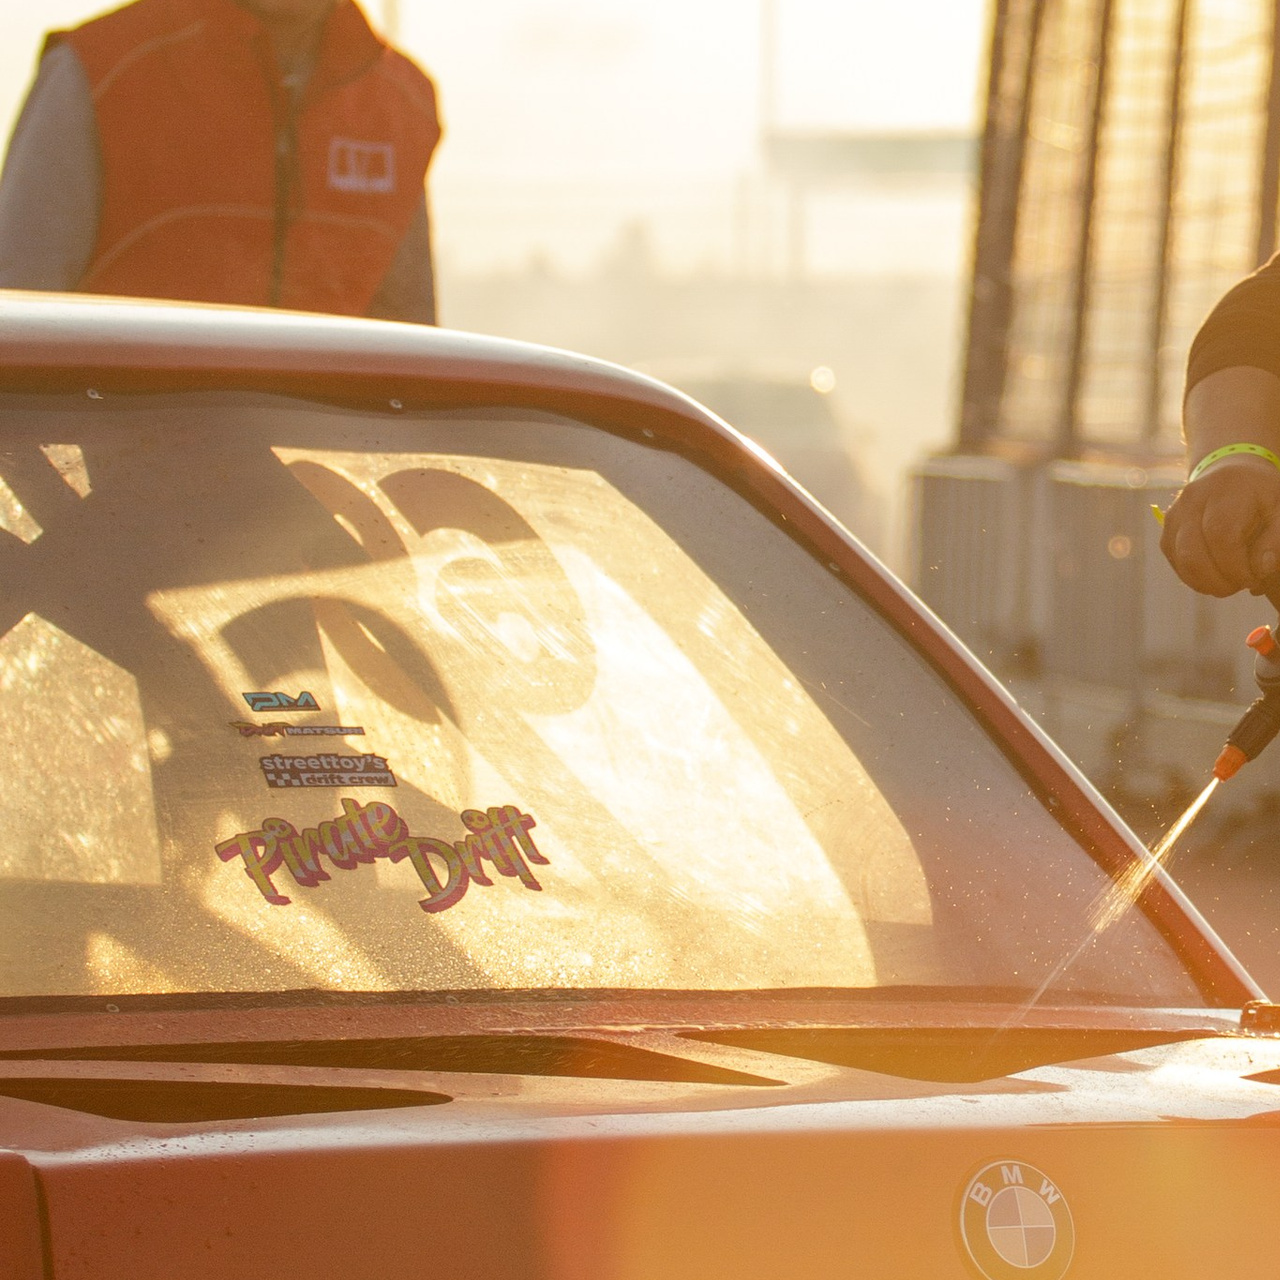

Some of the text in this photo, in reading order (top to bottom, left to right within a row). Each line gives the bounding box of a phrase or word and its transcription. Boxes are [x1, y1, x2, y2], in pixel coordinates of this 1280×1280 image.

[261, 754, 386, 772] streettoy's
[304, 772, 390, 785] drift crew
[215, 798, 550, 913] Pirate Drift
[968, 1165, 1061, 1207] BMW
